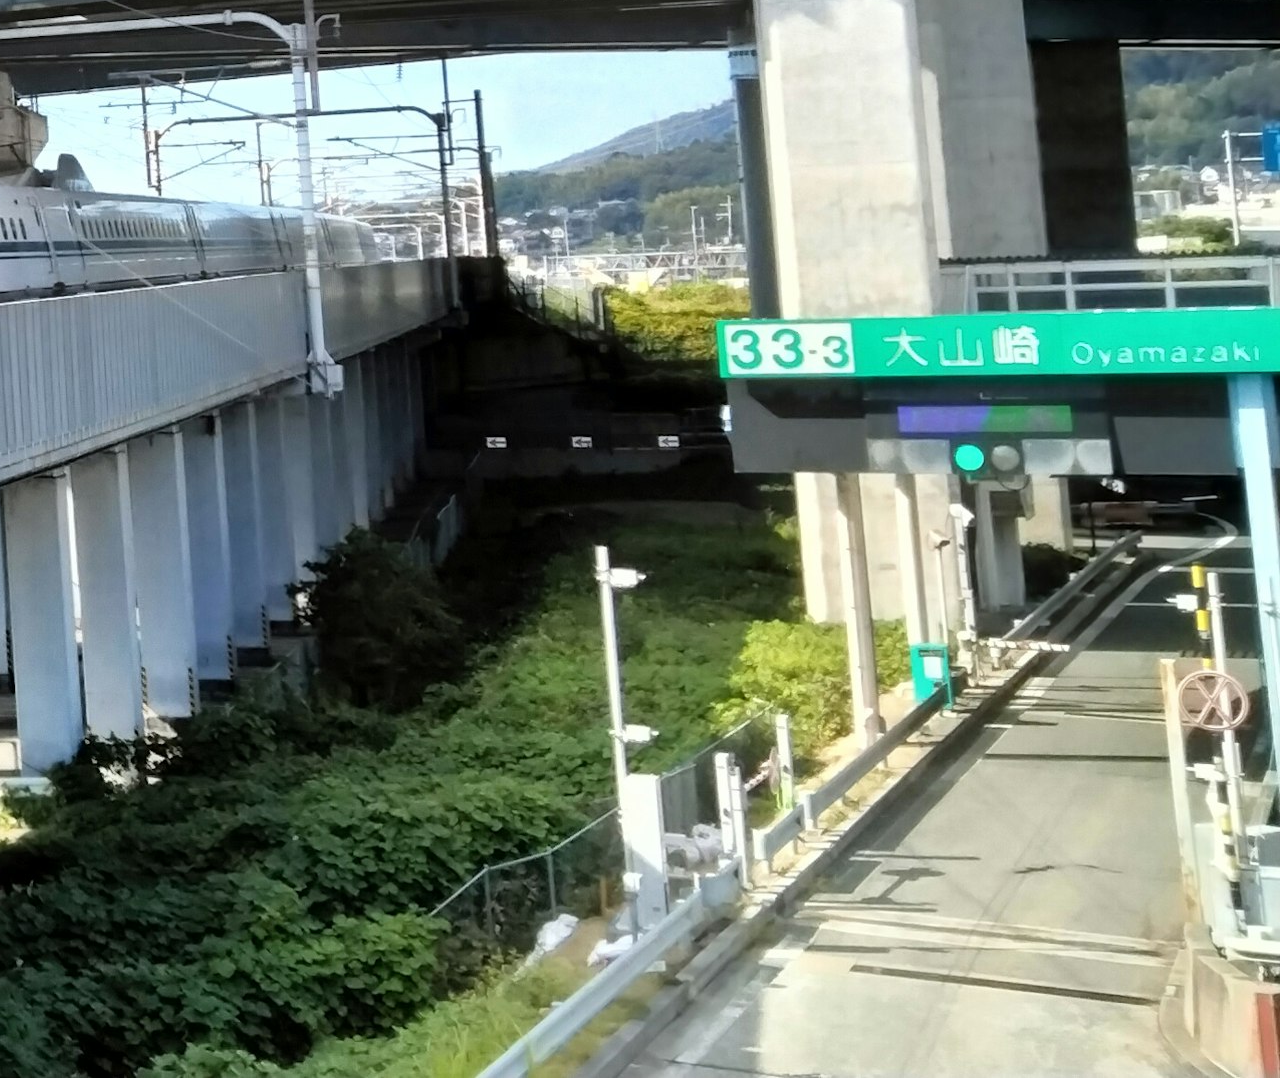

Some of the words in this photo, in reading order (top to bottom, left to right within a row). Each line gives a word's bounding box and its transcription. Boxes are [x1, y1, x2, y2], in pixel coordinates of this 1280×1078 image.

[730, 328, 850, 370] 33-3
[882, 324, 1040, 367] 大山崎
[1071, 341, 1261, 368] Oyamazaki
